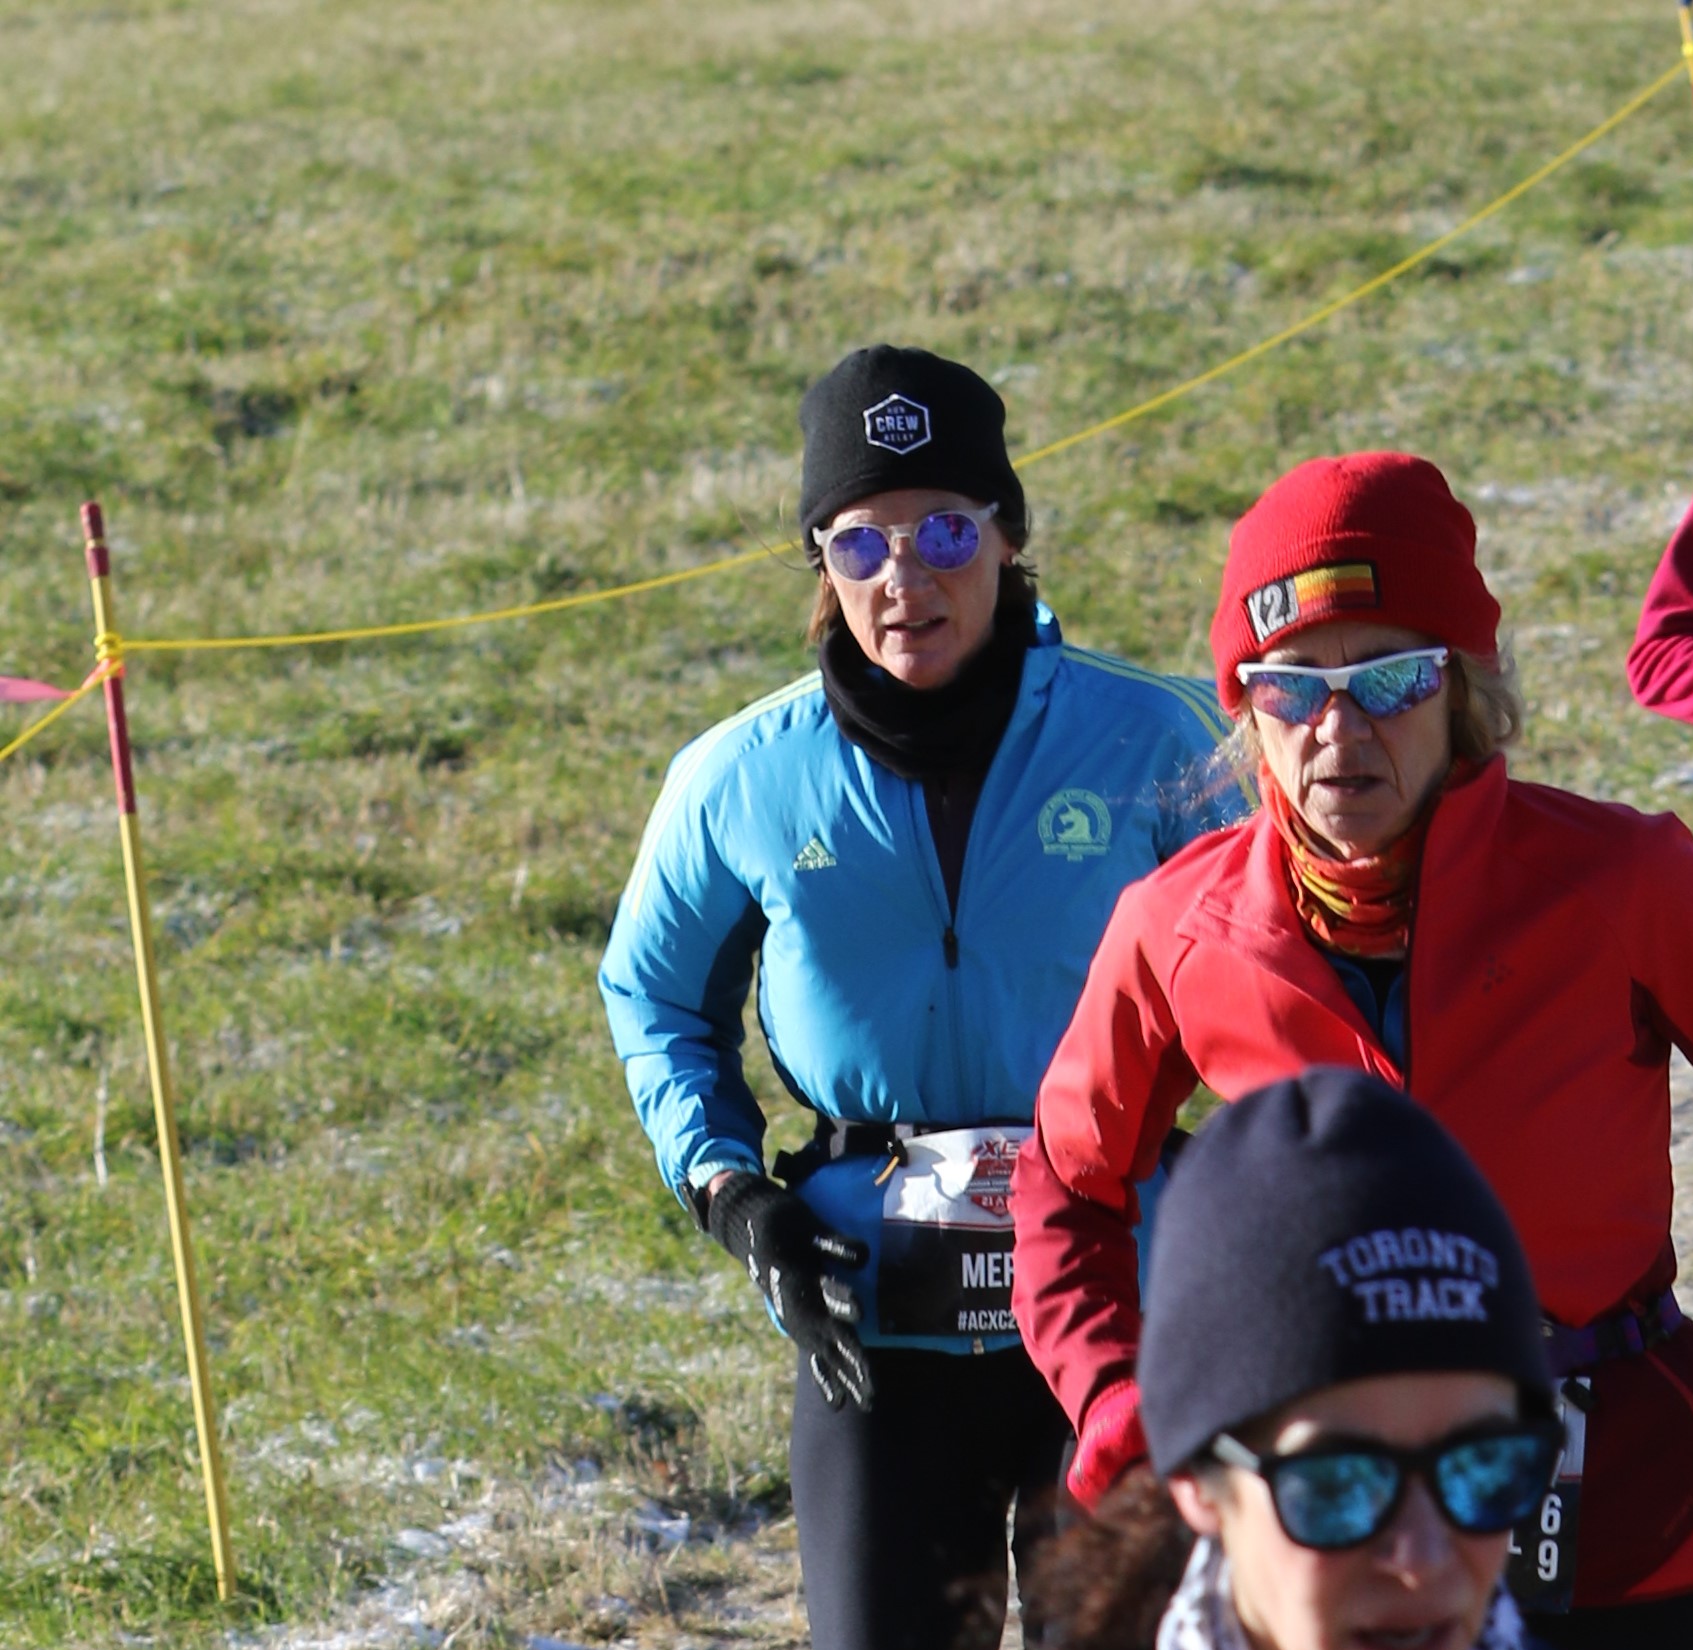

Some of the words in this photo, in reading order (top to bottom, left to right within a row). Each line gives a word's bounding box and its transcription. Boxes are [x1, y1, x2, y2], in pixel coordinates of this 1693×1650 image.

[875, 415, 918, 432] CREW
[1317, 1227, 1499, 1290] TORONTO
[1353, 1276, 1488, 1323] TRACK
